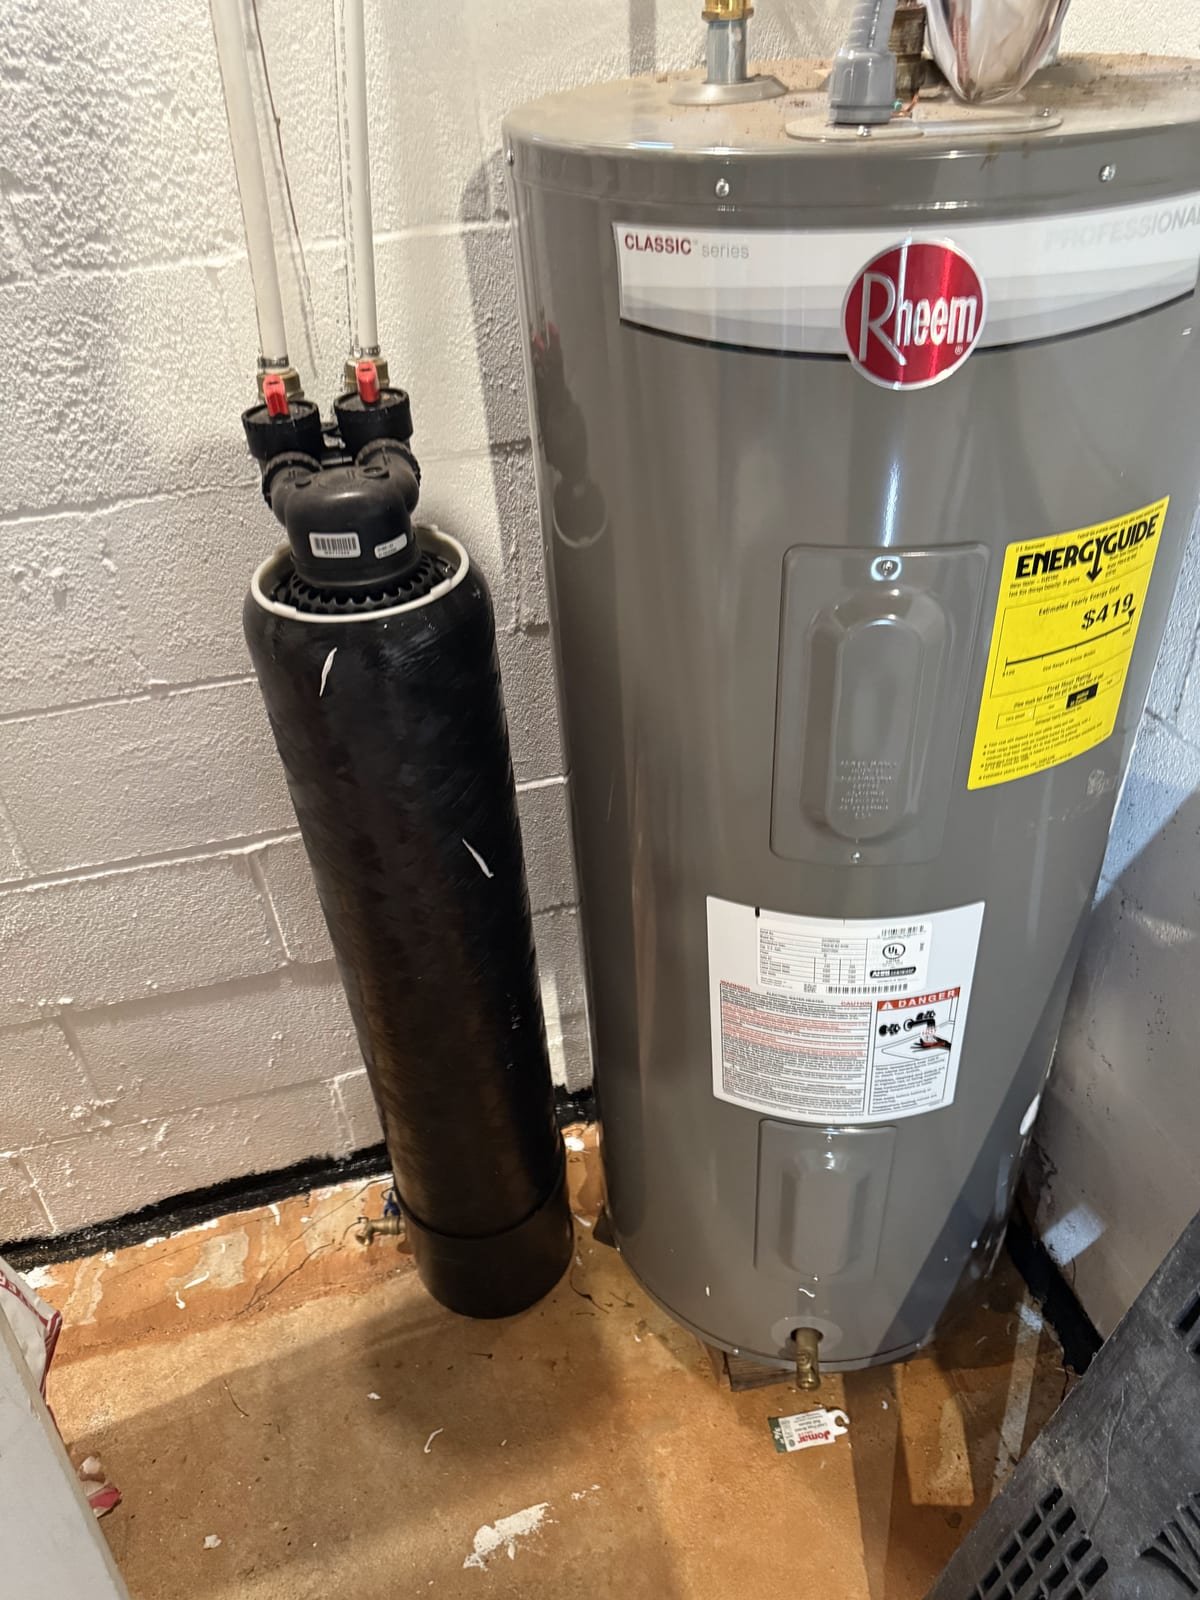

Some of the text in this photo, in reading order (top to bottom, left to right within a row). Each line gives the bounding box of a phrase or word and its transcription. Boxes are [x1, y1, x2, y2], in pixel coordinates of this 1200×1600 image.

[624, 233, 750, 259] CLASSIC series
[858, 260, 978, 366] Rheem
[1015, 513, 1160, 581] ENERGYGUIDE
[1081, 593, 1134, 631] $419
[898, 990, 955, 1008] DANGER
[797, 1430, 831, 1443] Jomar
